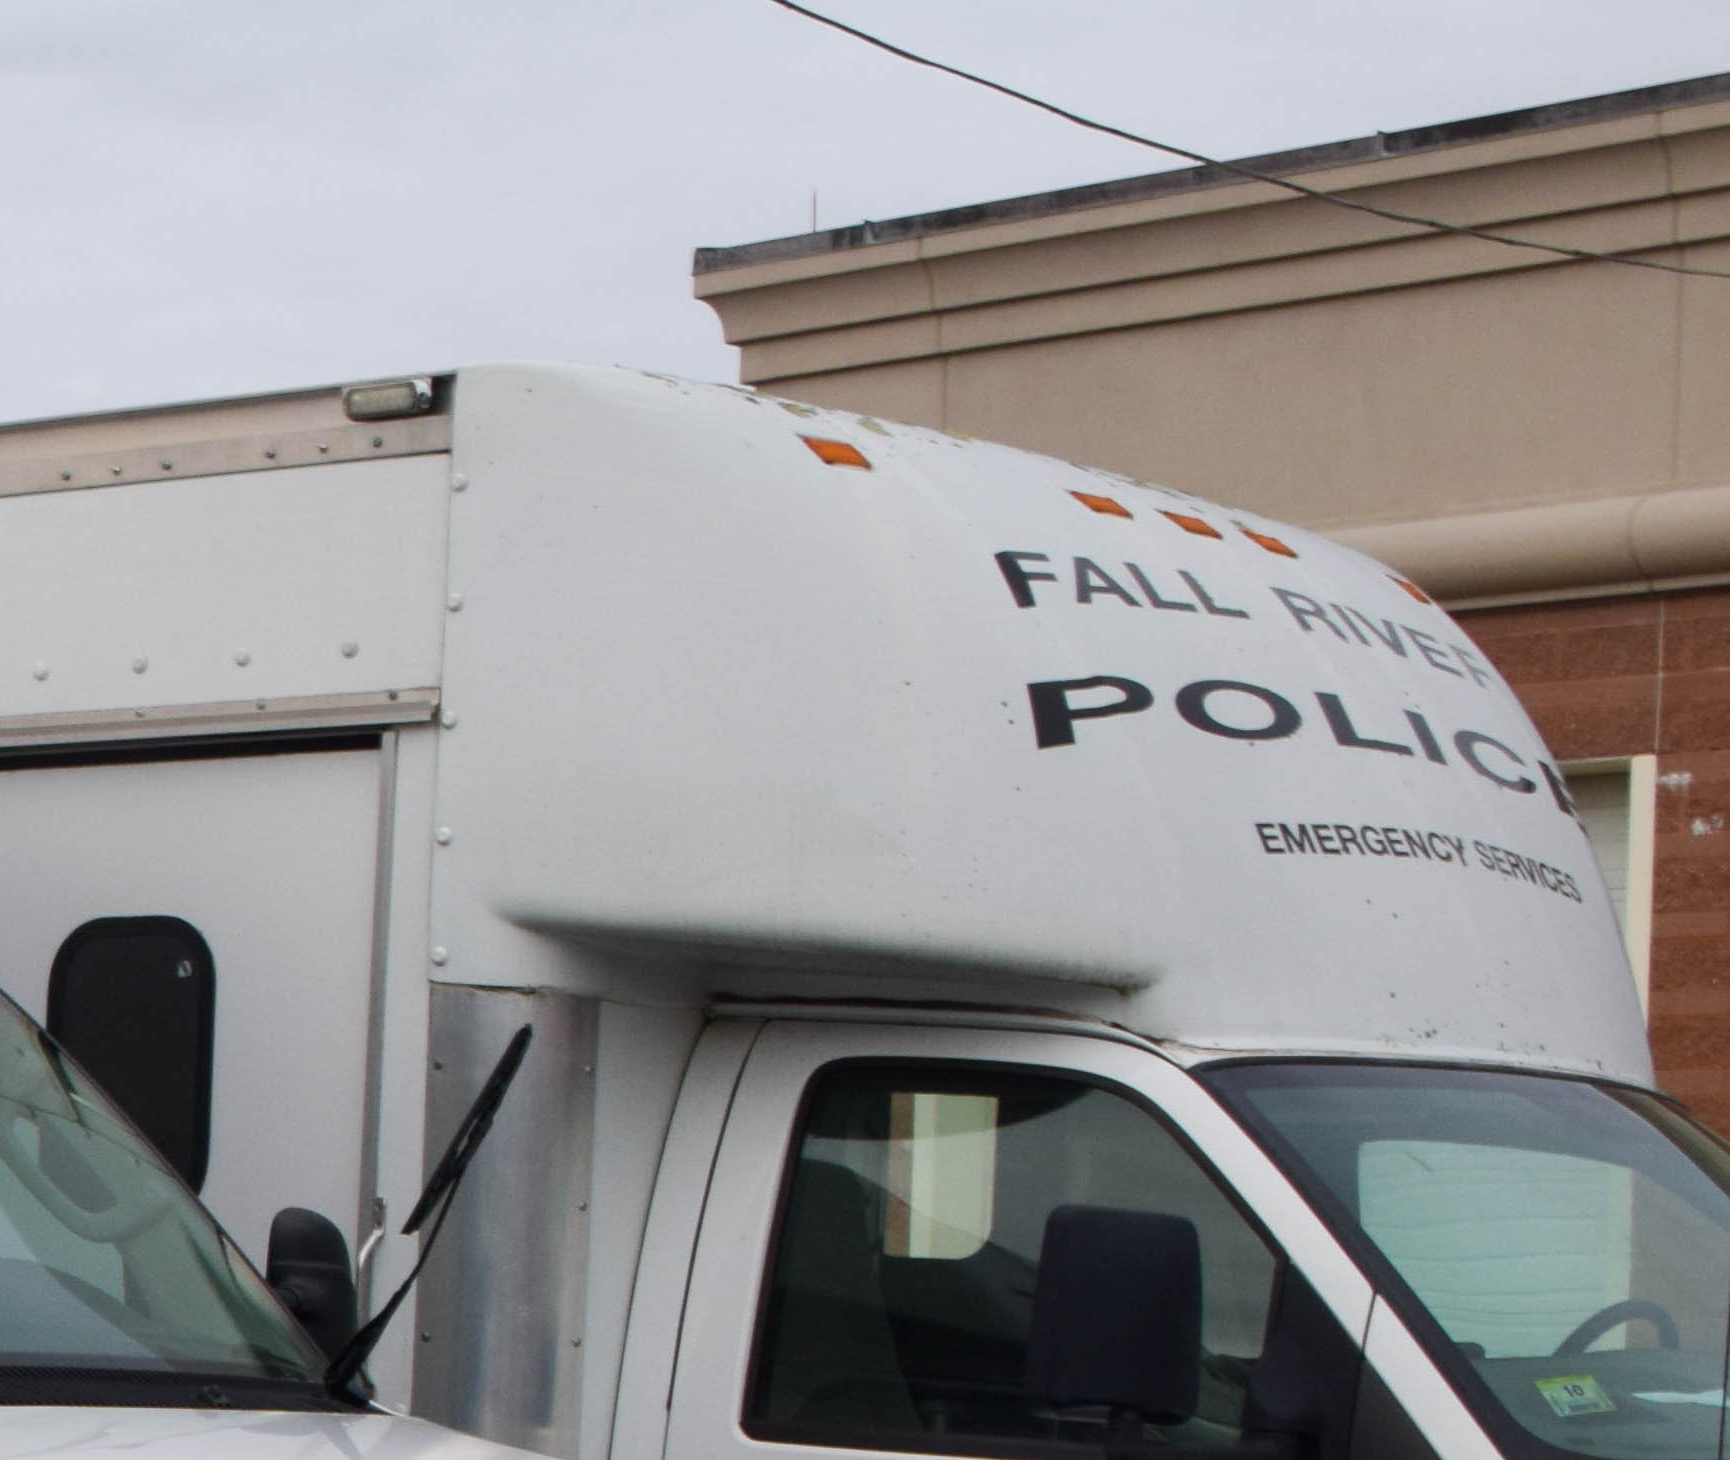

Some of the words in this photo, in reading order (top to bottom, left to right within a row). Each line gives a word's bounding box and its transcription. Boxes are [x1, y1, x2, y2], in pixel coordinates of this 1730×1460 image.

[994, 550, 1251, 620] FALL
[1255, 823, 1468, 868] EMERGENCY
[1474, 841, 1583, 904] SERVICES
